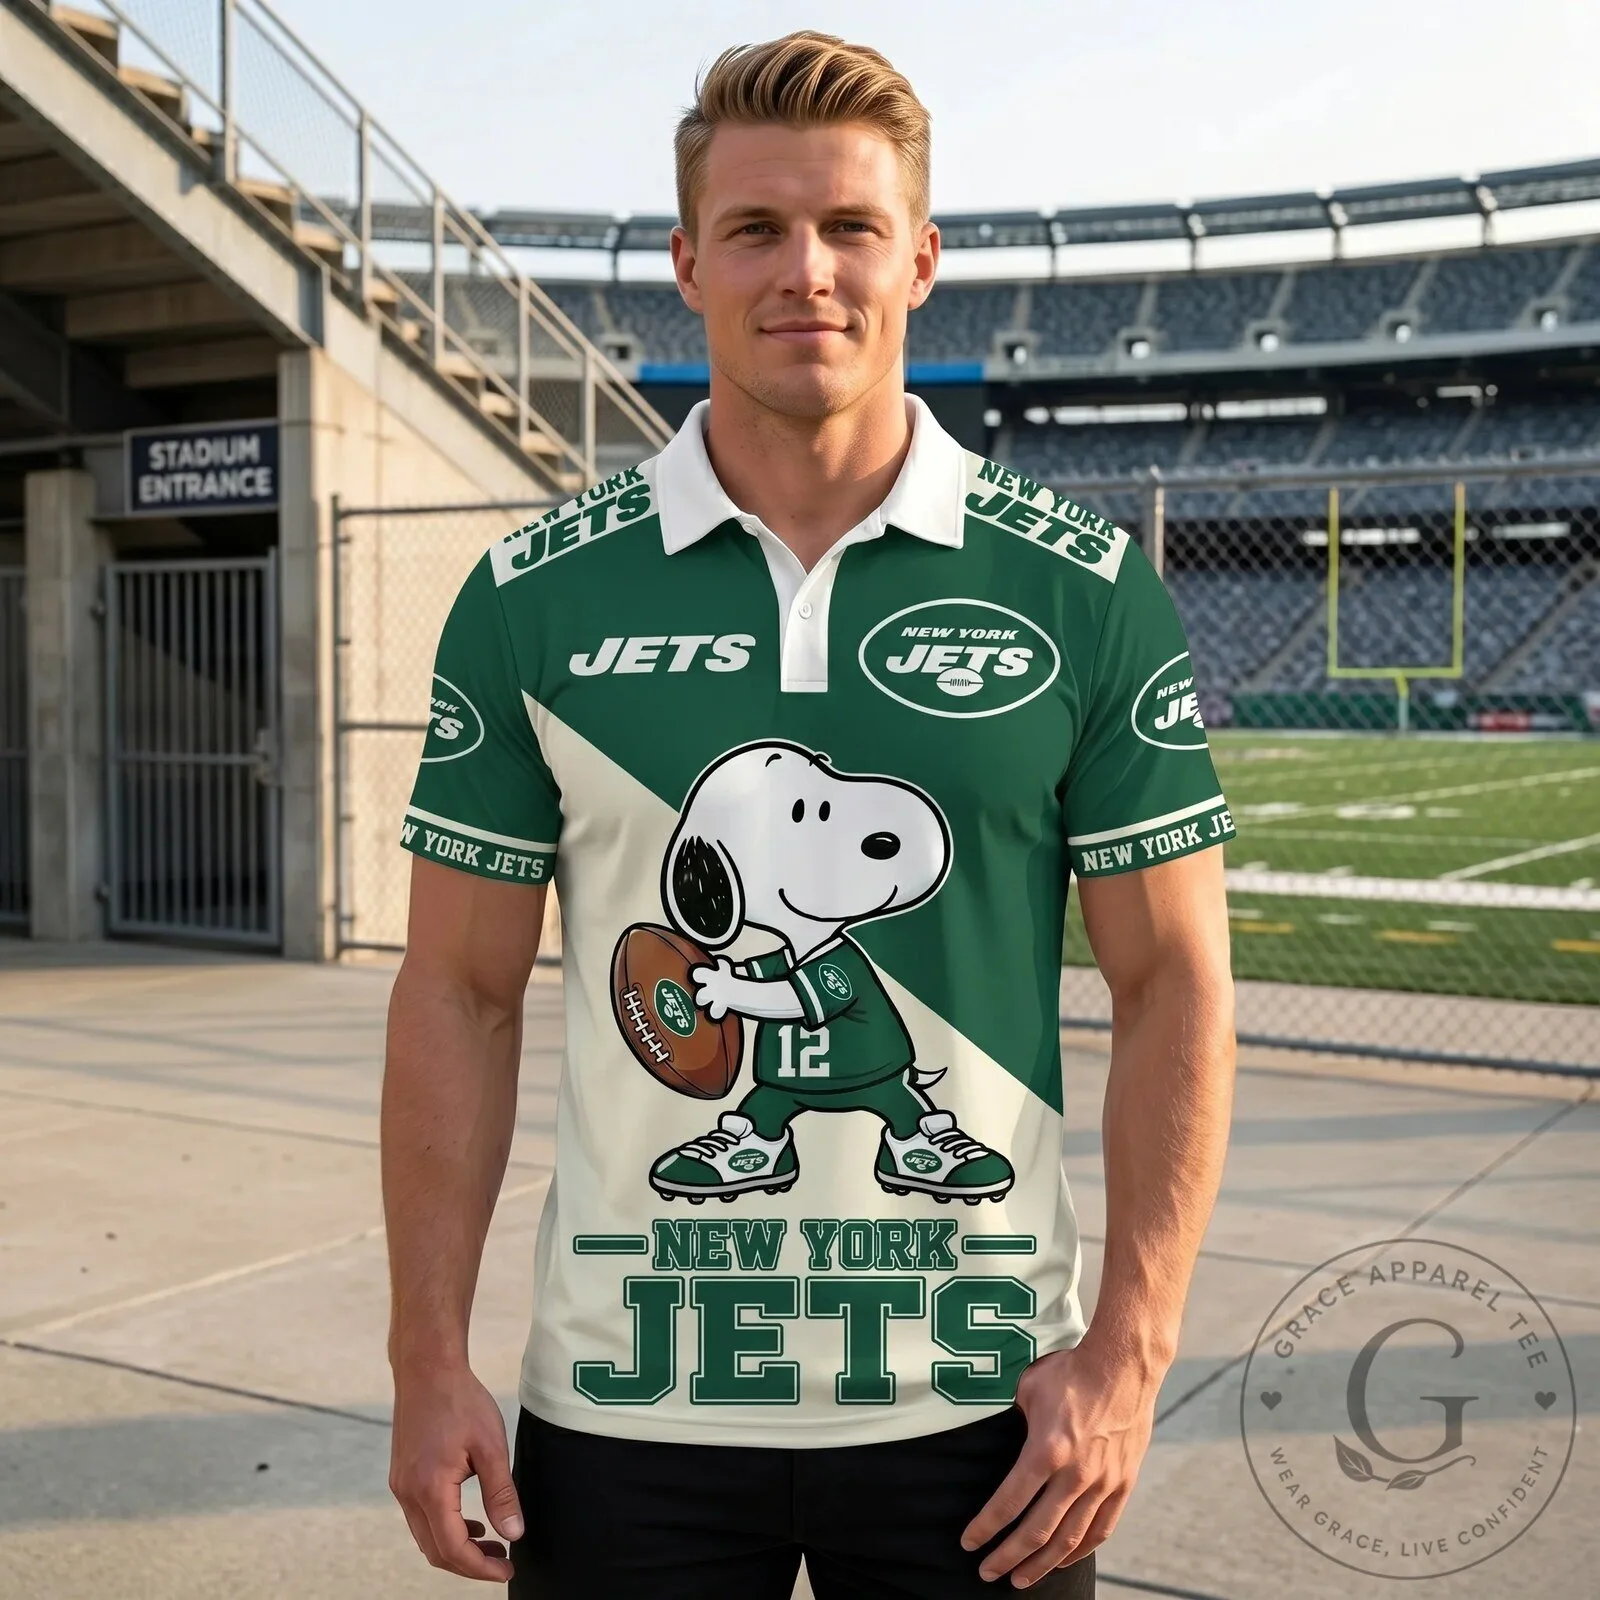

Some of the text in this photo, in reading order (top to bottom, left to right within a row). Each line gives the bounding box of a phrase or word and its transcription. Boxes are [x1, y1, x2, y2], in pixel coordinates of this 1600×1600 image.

[149, 434, 260, 471] STADIUM
[138, 466, 273, 503] ENTRANCE
[977, 459, 1118, 541] NEW YORK
[511, 483, 651, 570] JETS
[965, 491, 1111, 564] JETS
[901, 626, 1019, 640] NEW YORK
[568, 633, 756, 677] JETS
[885, 644, 1034, 677] JETS
[1156, 676, 1194, 700] NEW
[1154, 691, 1199, 730] JE
[424, 829, 483, 868] YORK
[486, 851, 545, 879] JETS
[1081, 810, 1236, 872] NEW YORK JE
[661, 987, 689, 1028] JETS
[777, 1024, 830, 1078] 12
[731, 1156, 765, 1167] JETS
[905, 1156, 938, 1167] JETS
[652, 1218, 958, 1271] NEW YORK
[573, 1275, 1037, 1406] JETS
